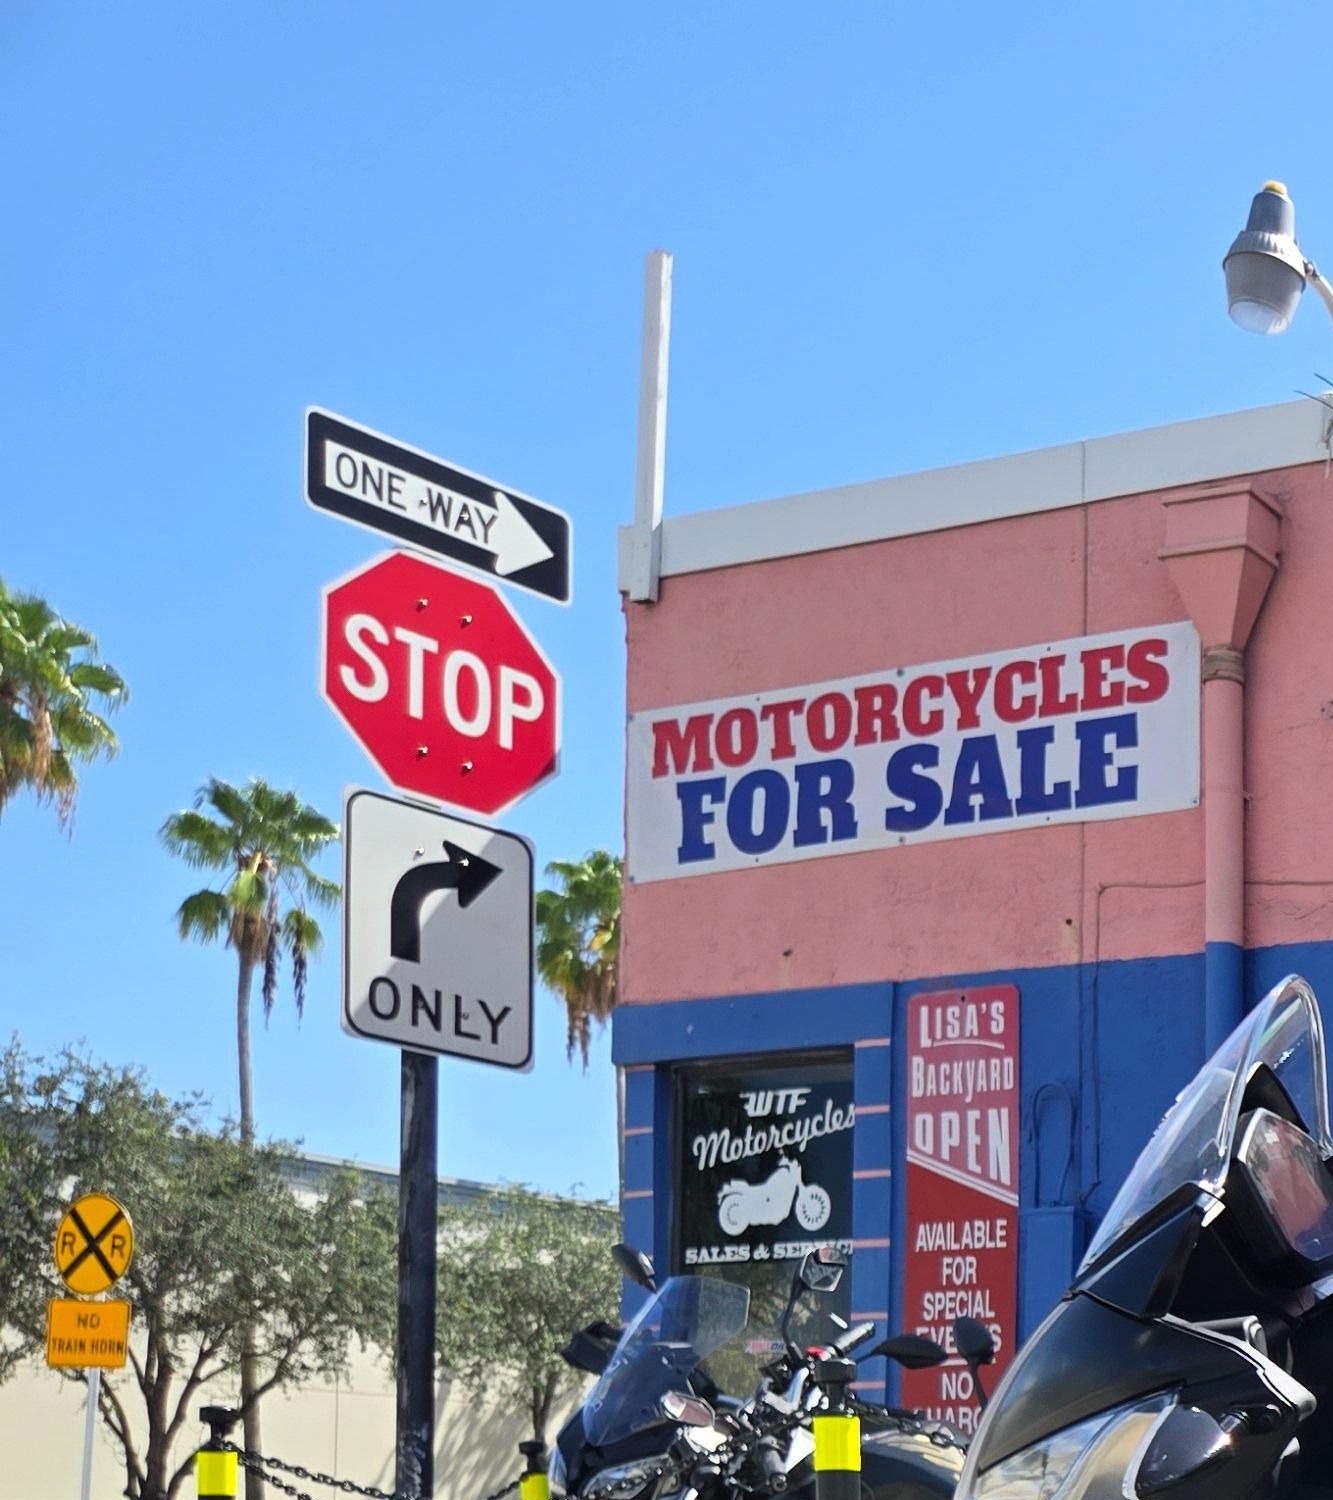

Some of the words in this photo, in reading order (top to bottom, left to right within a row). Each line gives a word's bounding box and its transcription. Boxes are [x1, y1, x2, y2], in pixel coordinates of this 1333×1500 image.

[335, 452, 406, 511] ONE
[426, 487, 498, 544] WAY
[339, 613, 544, 750] STOP
[651, 638, 1170, 780] MOTORCYCLES
[676, 758, 858, 865] FOR
[885, 712, 1139, 832] SALE
[368, 975, 512, 1045] ONLY
[739, 1088, 812, 1117] WTF
[692, 1098, 855, 1171] Motorcycles
[914, 1107, 1011, 1186] OPEN
[915, 1219, 1007, 1252] AVAILABLE
[685, 1246, 750, 1265] SALES
[753, 1243, 770, 1259] &
[942, 1256, 977, 1285] FOR
[77, 1312, 100, 1330] NO
[923, 1290, 995, 1321] SPECIAL
[52, 1338, 87, 1354] TRAIN
[91, 1340, 124, 1355] HORN
[942, 1371, 974, 1400] NO
